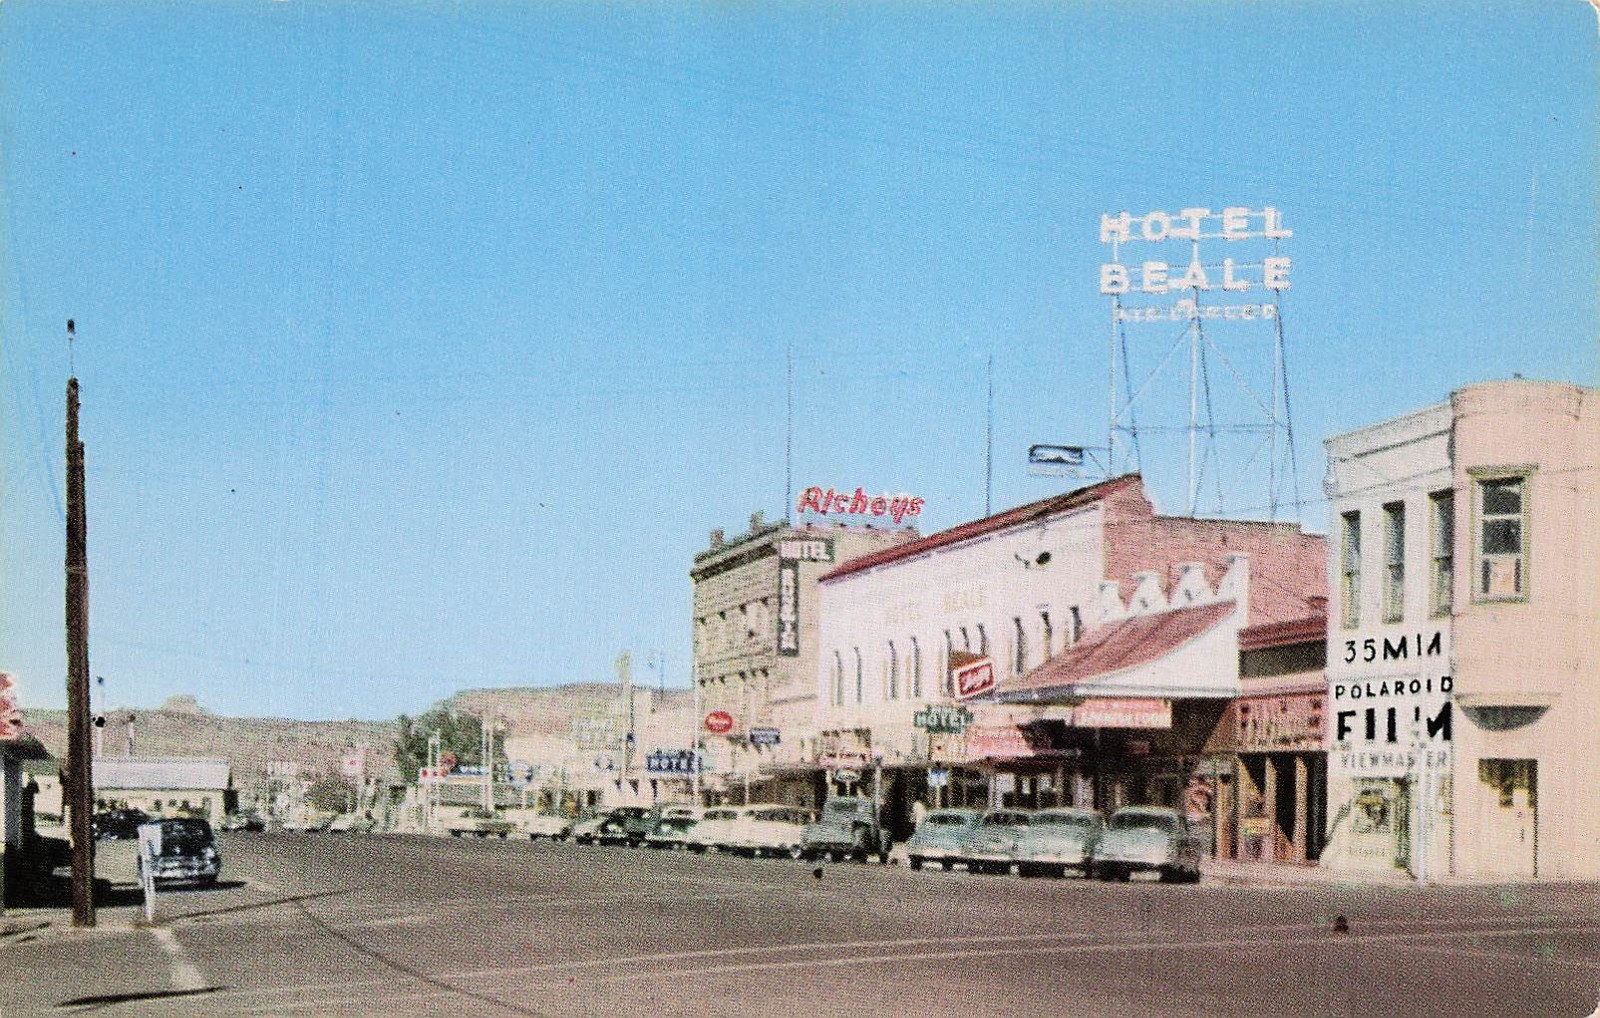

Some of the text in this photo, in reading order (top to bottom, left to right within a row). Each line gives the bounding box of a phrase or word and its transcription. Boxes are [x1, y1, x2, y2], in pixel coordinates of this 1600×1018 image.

[1101, 207, 1293, 243] HOTEL
[1101, 257, 1292, 294] BEALE
[1335, 676, 1453, 699] POLAROID
